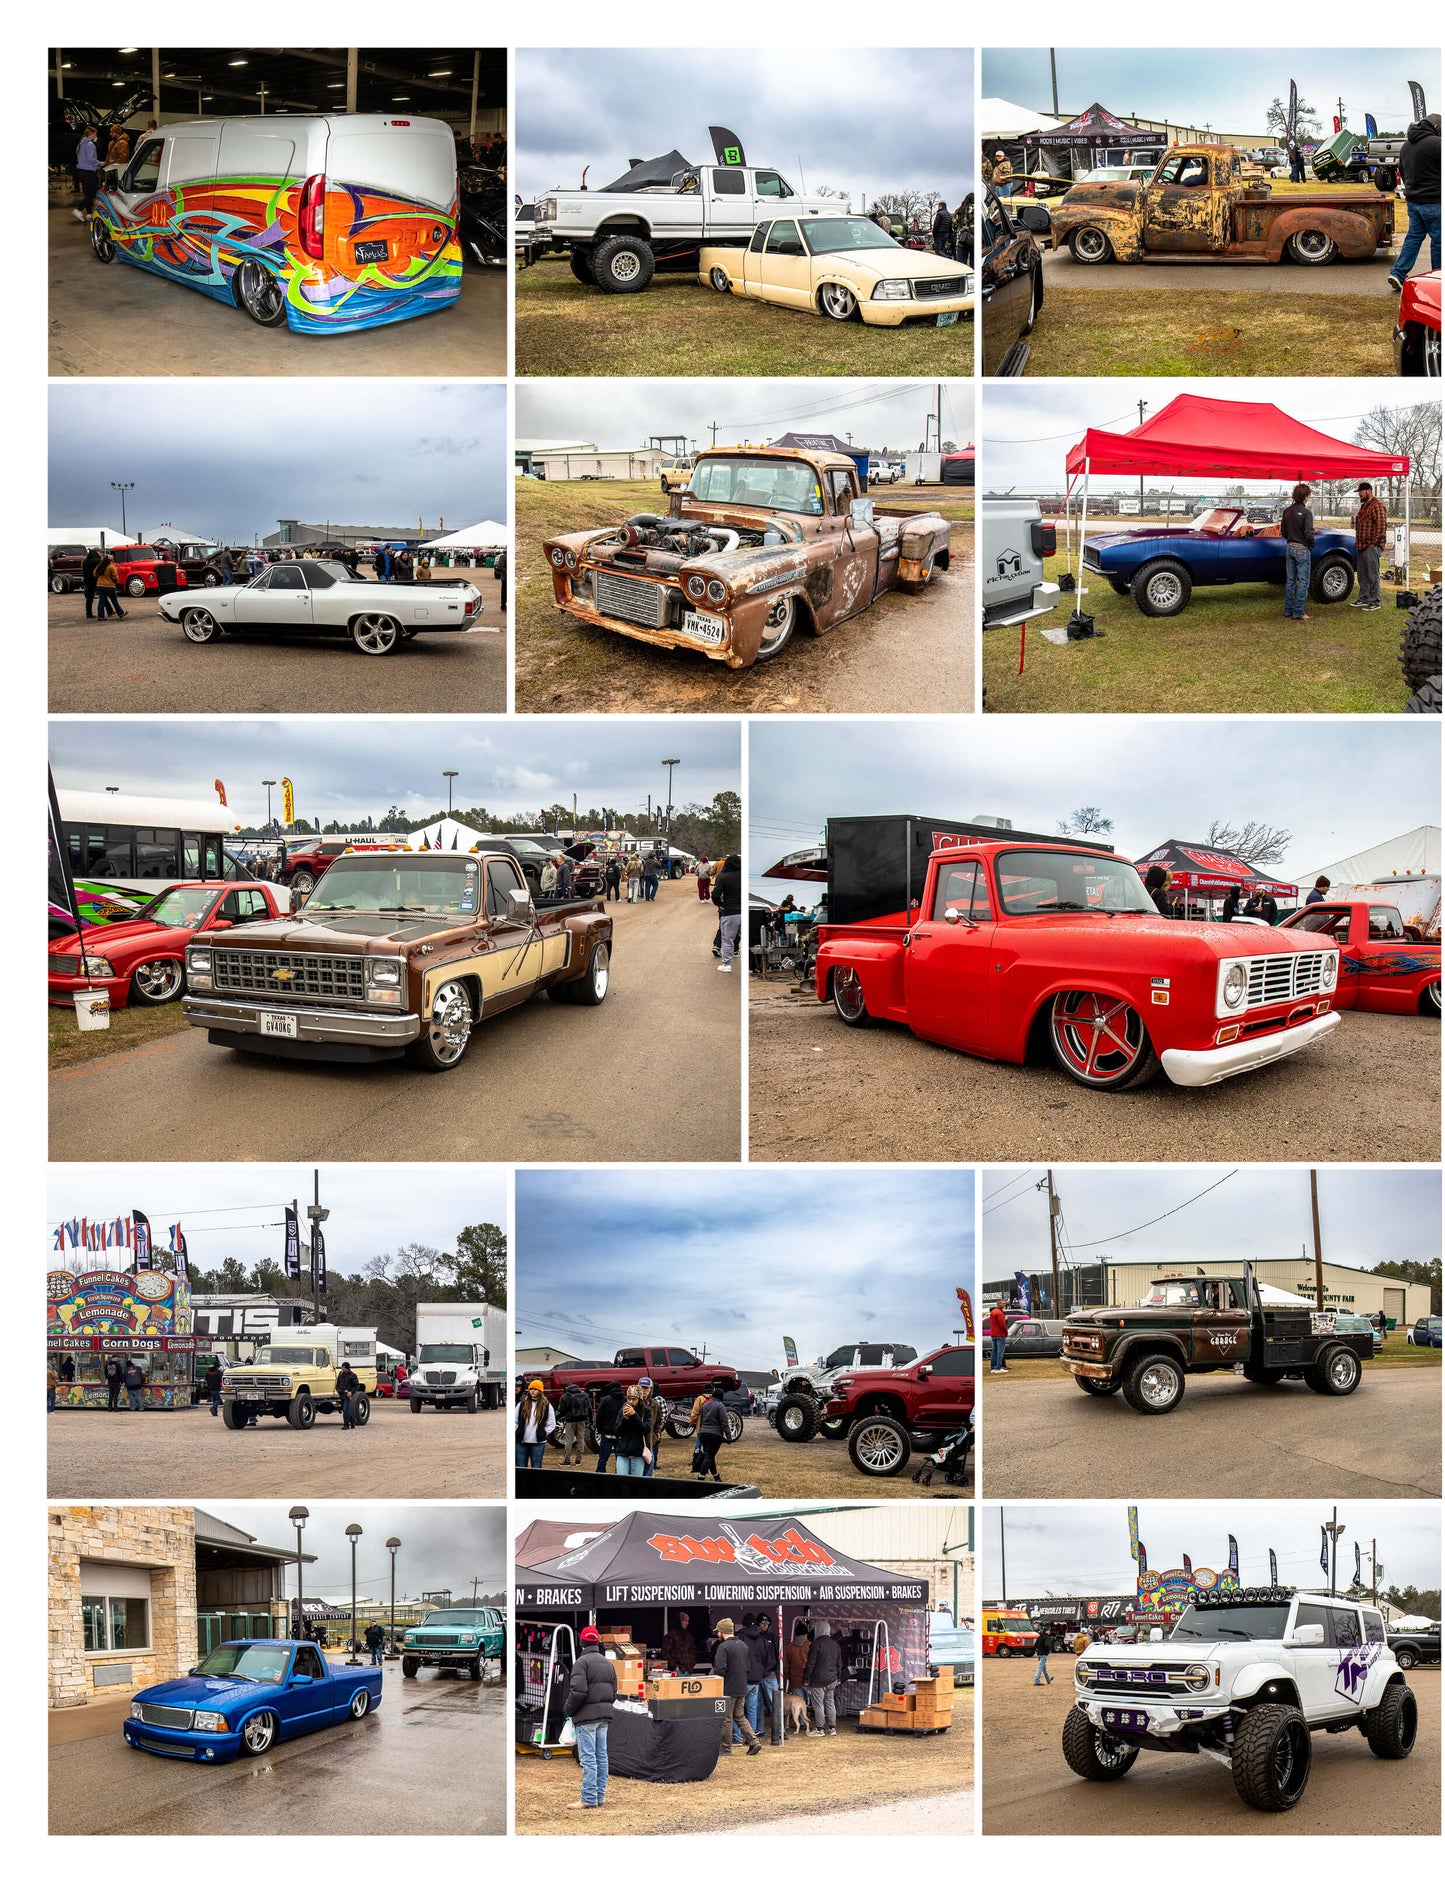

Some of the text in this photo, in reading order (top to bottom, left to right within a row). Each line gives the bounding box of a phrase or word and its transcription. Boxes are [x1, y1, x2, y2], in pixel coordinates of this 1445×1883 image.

[697, 615, 711, 624] TEXAS
[79, 1273, 129, 1286] Funnel Cakes
[1322, 1294, 1342, 1302] OUNTY
[79, 1307, 129, 1320] Lemonade
[63, 1338, 91, 1348] Cakes
[102, 1338, 161, 1350] Corn Dogs
[167, 1340, 195, 1350] Lemonade
[1210, 1336, 1237, 1346] GARAGE
[536, 1588, 583, 1605] BRAKES
[606, 1585, 922, 1602] LIFT SUSPENSION LOWERING SUSPENSION AIR SUSPENSION BRAKES
[1162, 1594, 1188, 1602] Lemonad
[1062, 1606, 1076, 1615] TIRES
[1148, 1613, 1164, 1621] Cakes
[1096, 1669, 1167, 1683] FORD
